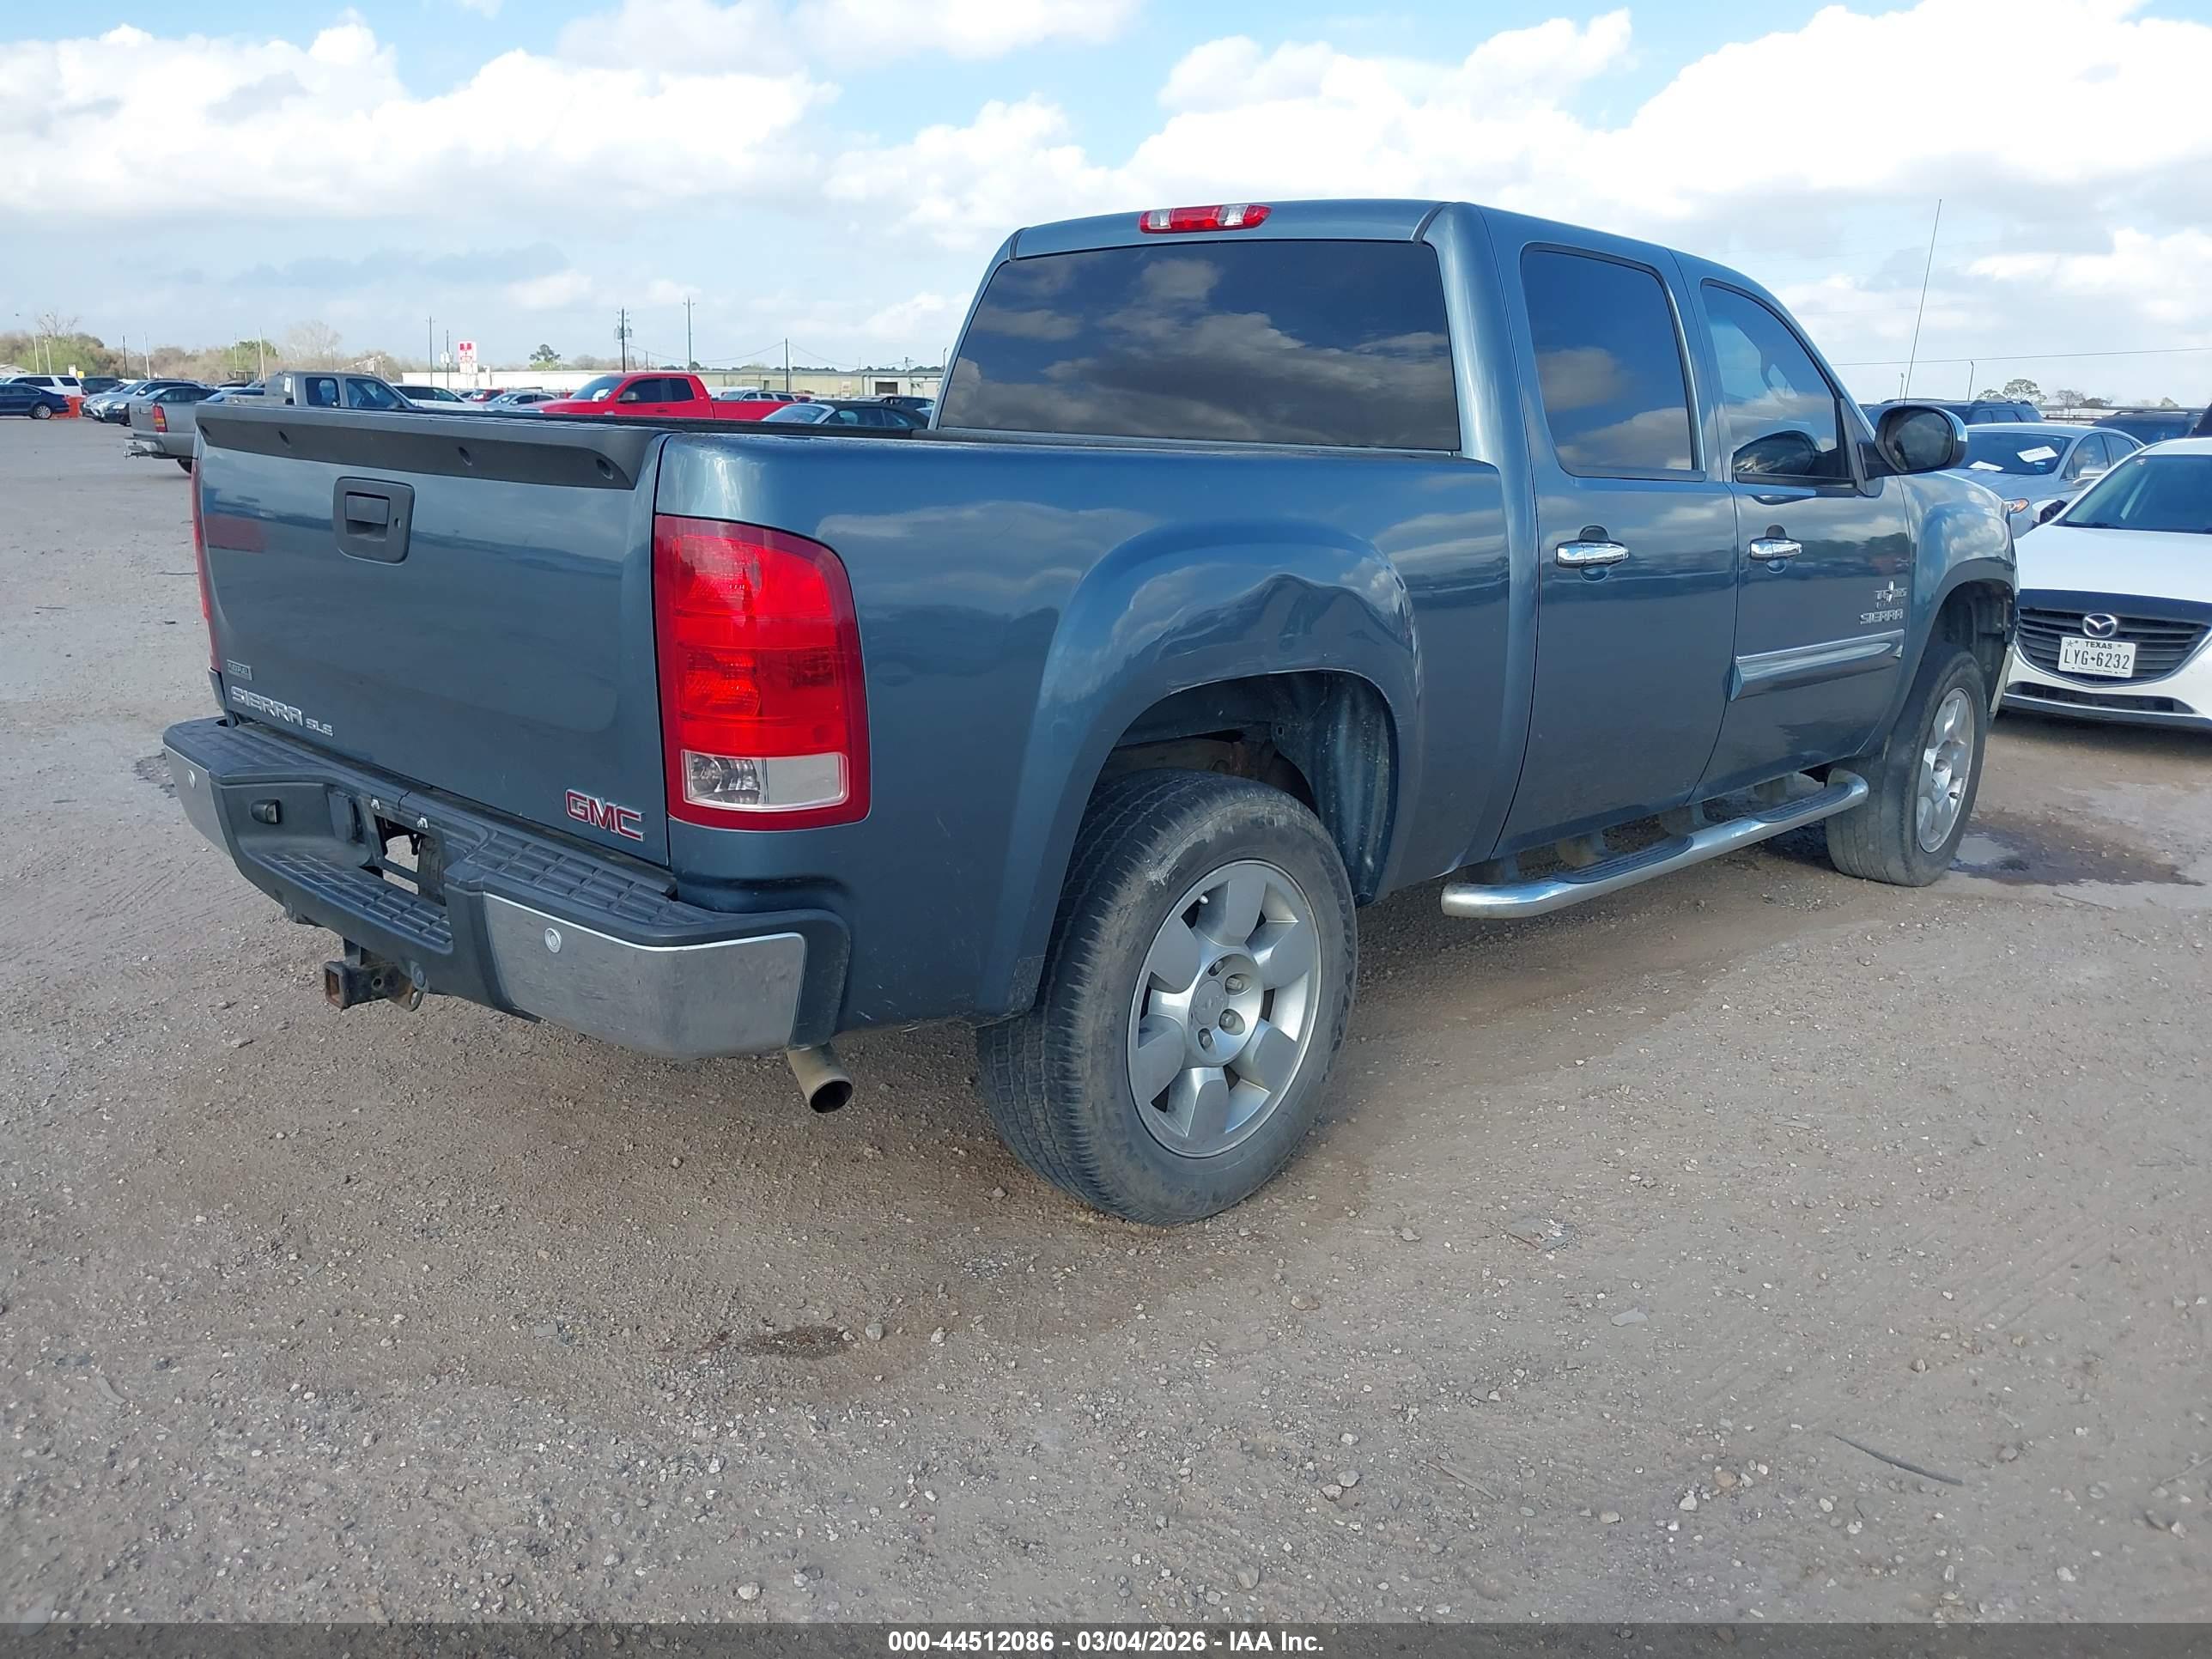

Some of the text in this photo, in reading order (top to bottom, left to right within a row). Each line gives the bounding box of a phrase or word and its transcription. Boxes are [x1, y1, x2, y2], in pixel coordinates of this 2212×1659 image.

[1860, 609, 1904, 625] SIERRA
[2085, 641, 2113, 650] TEXAS
[230, 685, 335, 737] SIERRA SLE
[565, 788, 646, 842] GMC
